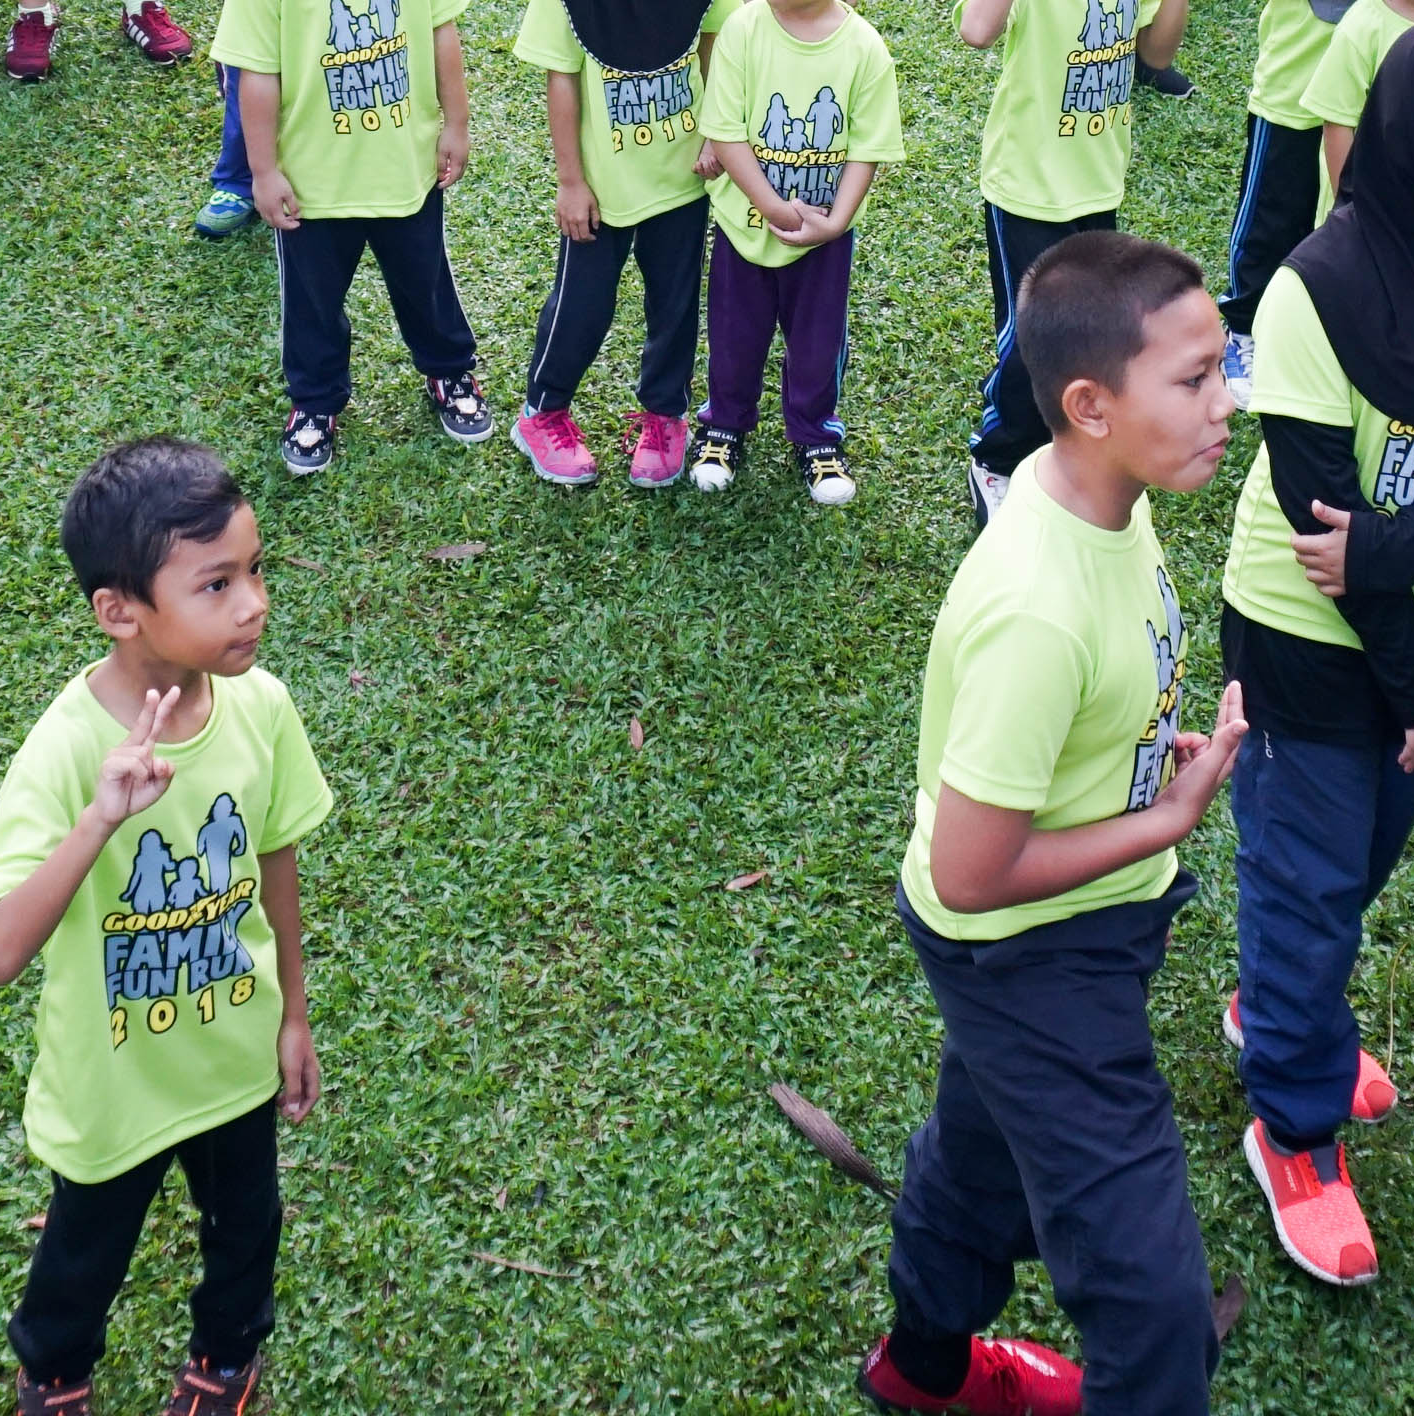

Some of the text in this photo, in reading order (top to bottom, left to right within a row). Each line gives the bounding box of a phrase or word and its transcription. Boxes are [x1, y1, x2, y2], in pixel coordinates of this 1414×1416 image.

[329, 85, 377, 112] FUN
[603, 64, 691, 107] FAMILY
[1061, 89, 1107, 114] FUN
[607, 87, 694, 129] FUN RUN
[613, 107, 696, 154] 2018
[753, 144, 847, 168] GOODYEAR
[103, 878, 256, 932] GOODYEAR
[106, 942, 254, 1010] FUN RUN
[111, 975, 256, 1051] 2018
